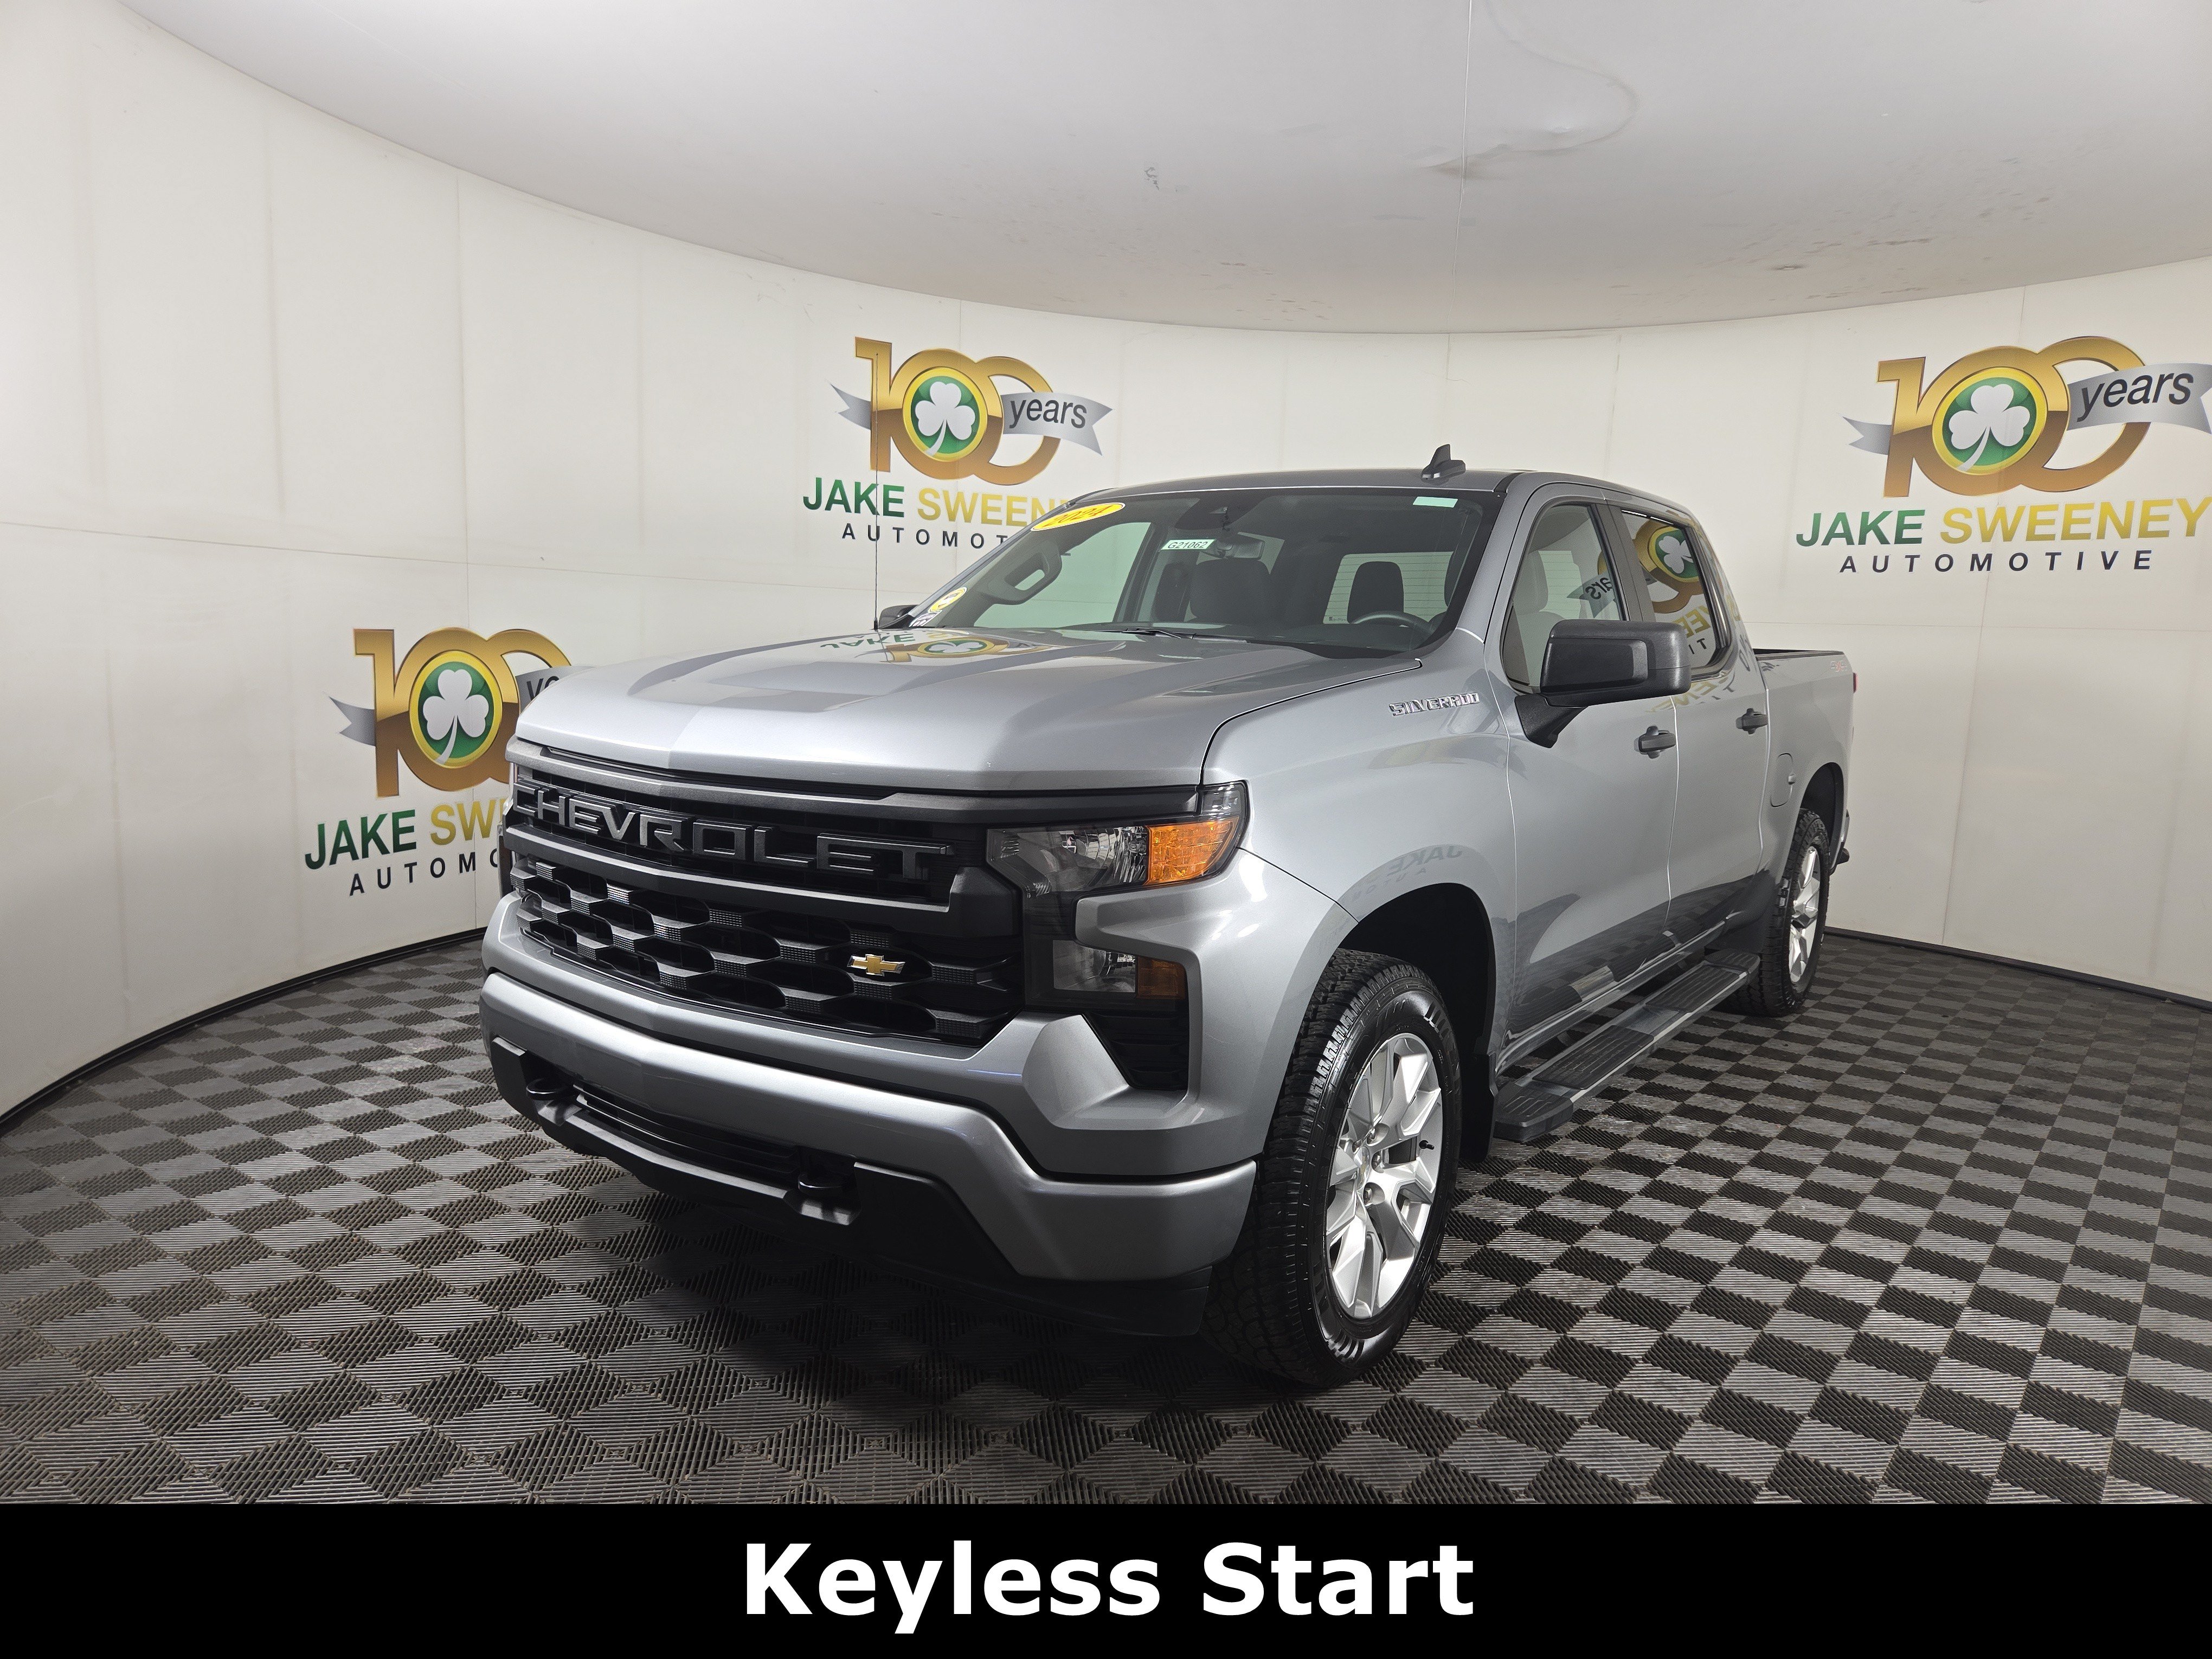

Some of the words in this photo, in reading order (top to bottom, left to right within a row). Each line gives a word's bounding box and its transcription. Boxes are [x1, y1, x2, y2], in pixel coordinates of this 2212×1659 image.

[1009, 397, 1087, 429] years
[2076, 371, 2194, 422] years
[803, 477, 905, 518] JAKE
[917, 487, 1070, 527] SWEEN
[1041, 505, 1114, 528] 2024
[1796, 509, 1926, 547] JAKE
[1939, 496, 2212, 544] SWEENEY
[1839, 550, 2152, 574] AUTOMOTIVE
[305, 809, 417, 870] JAKE
[513, 780, 955, 880] CHEVROLET
